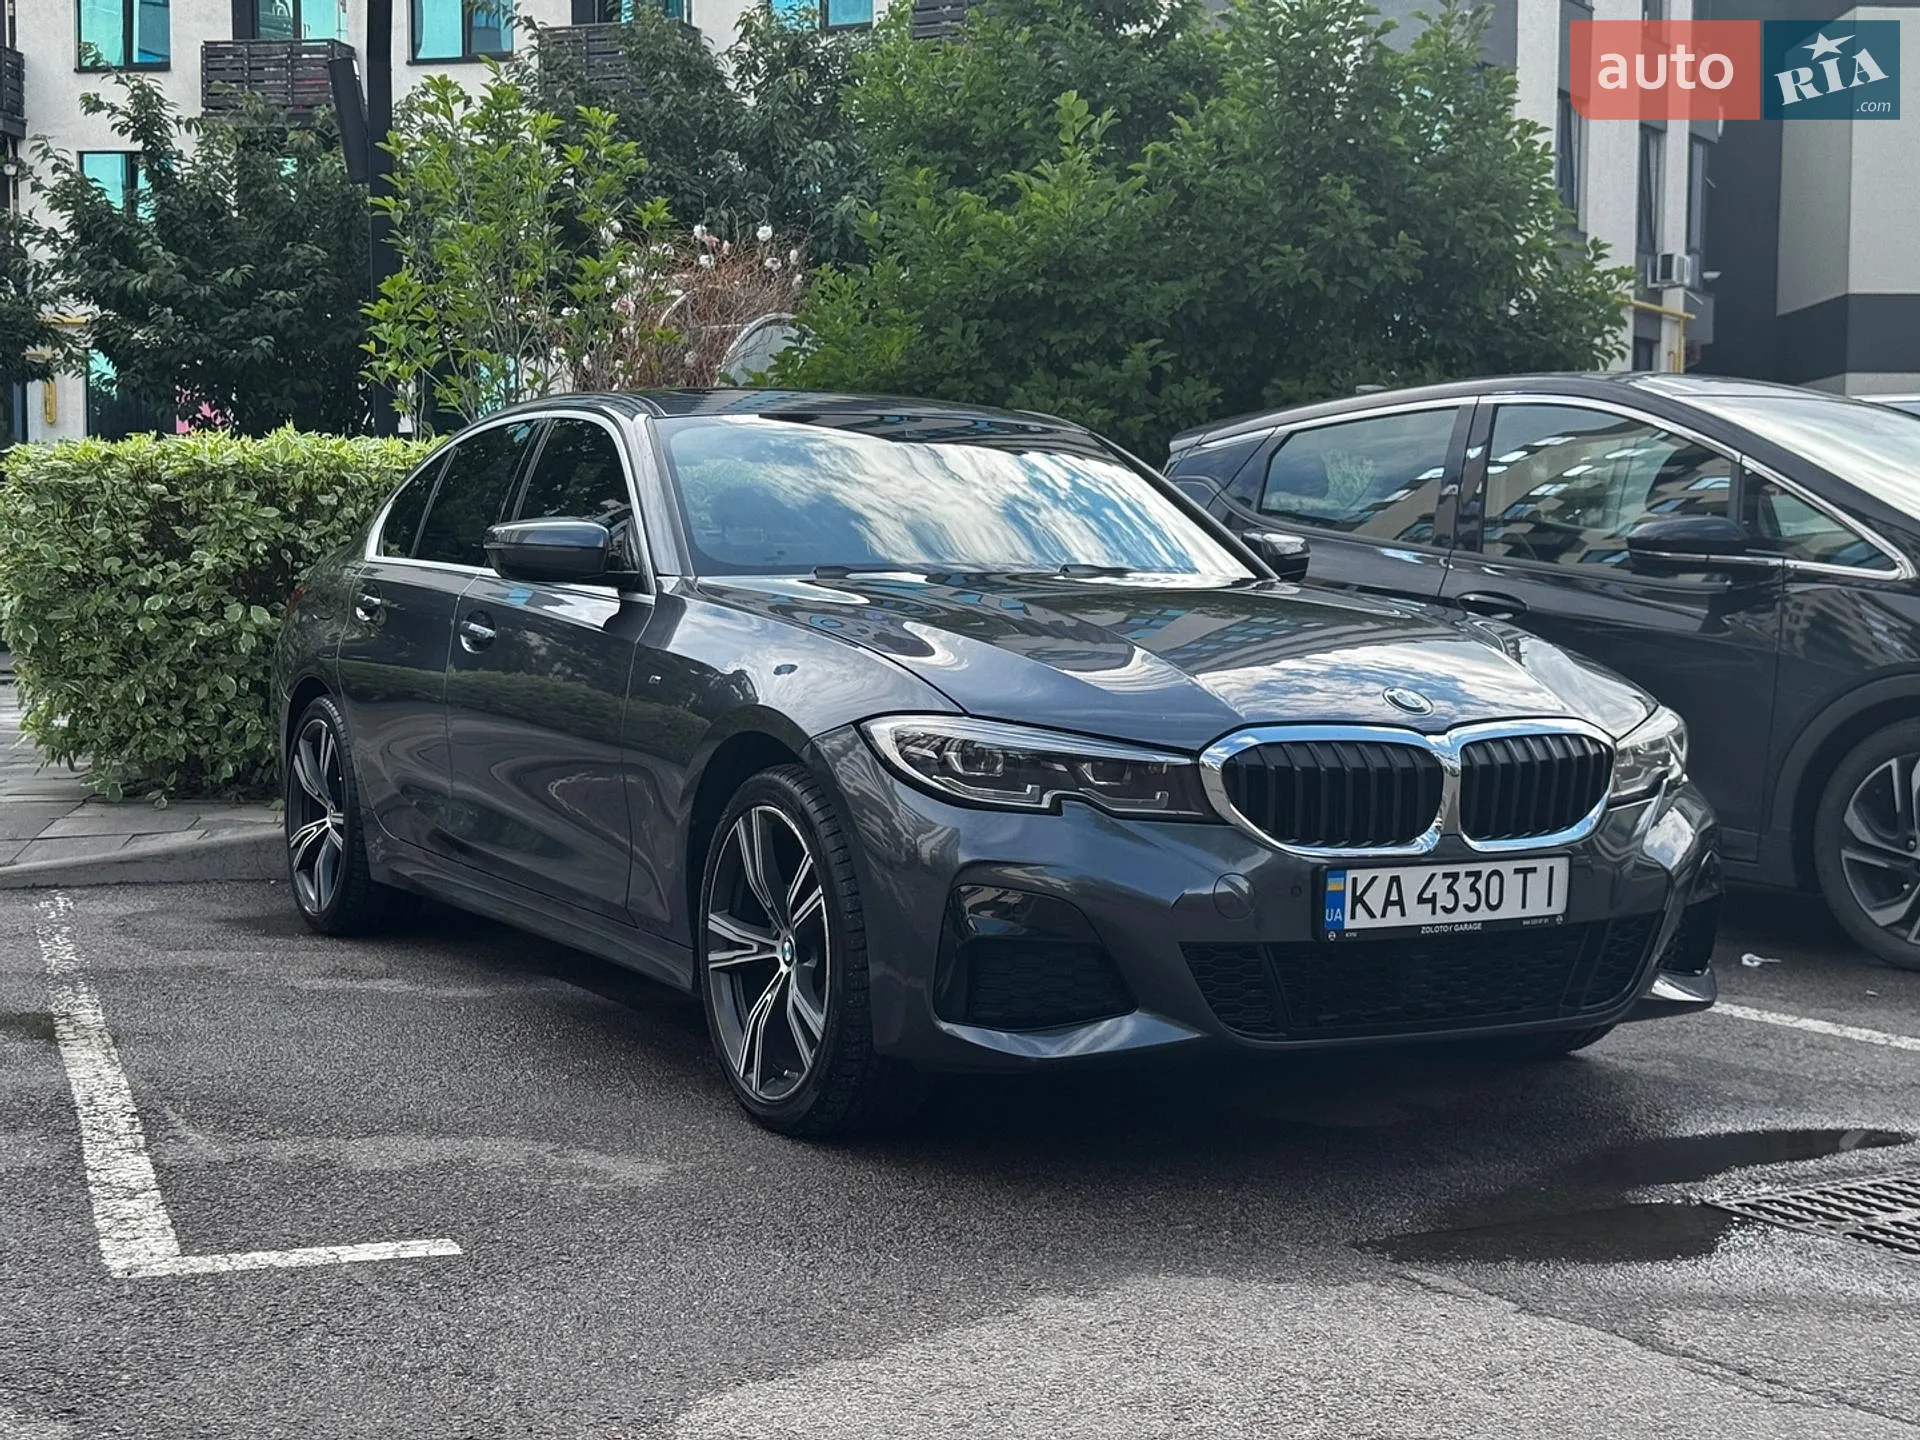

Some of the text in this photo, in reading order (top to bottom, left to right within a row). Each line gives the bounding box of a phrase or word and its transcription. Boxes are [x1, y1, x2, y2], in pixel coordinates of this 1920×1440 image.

[1349, 865, 1554, 920] KA 4330 TI
[1325, 908, 1343, 922] UA
[1453, 922, 1482, 932] GARAGE
